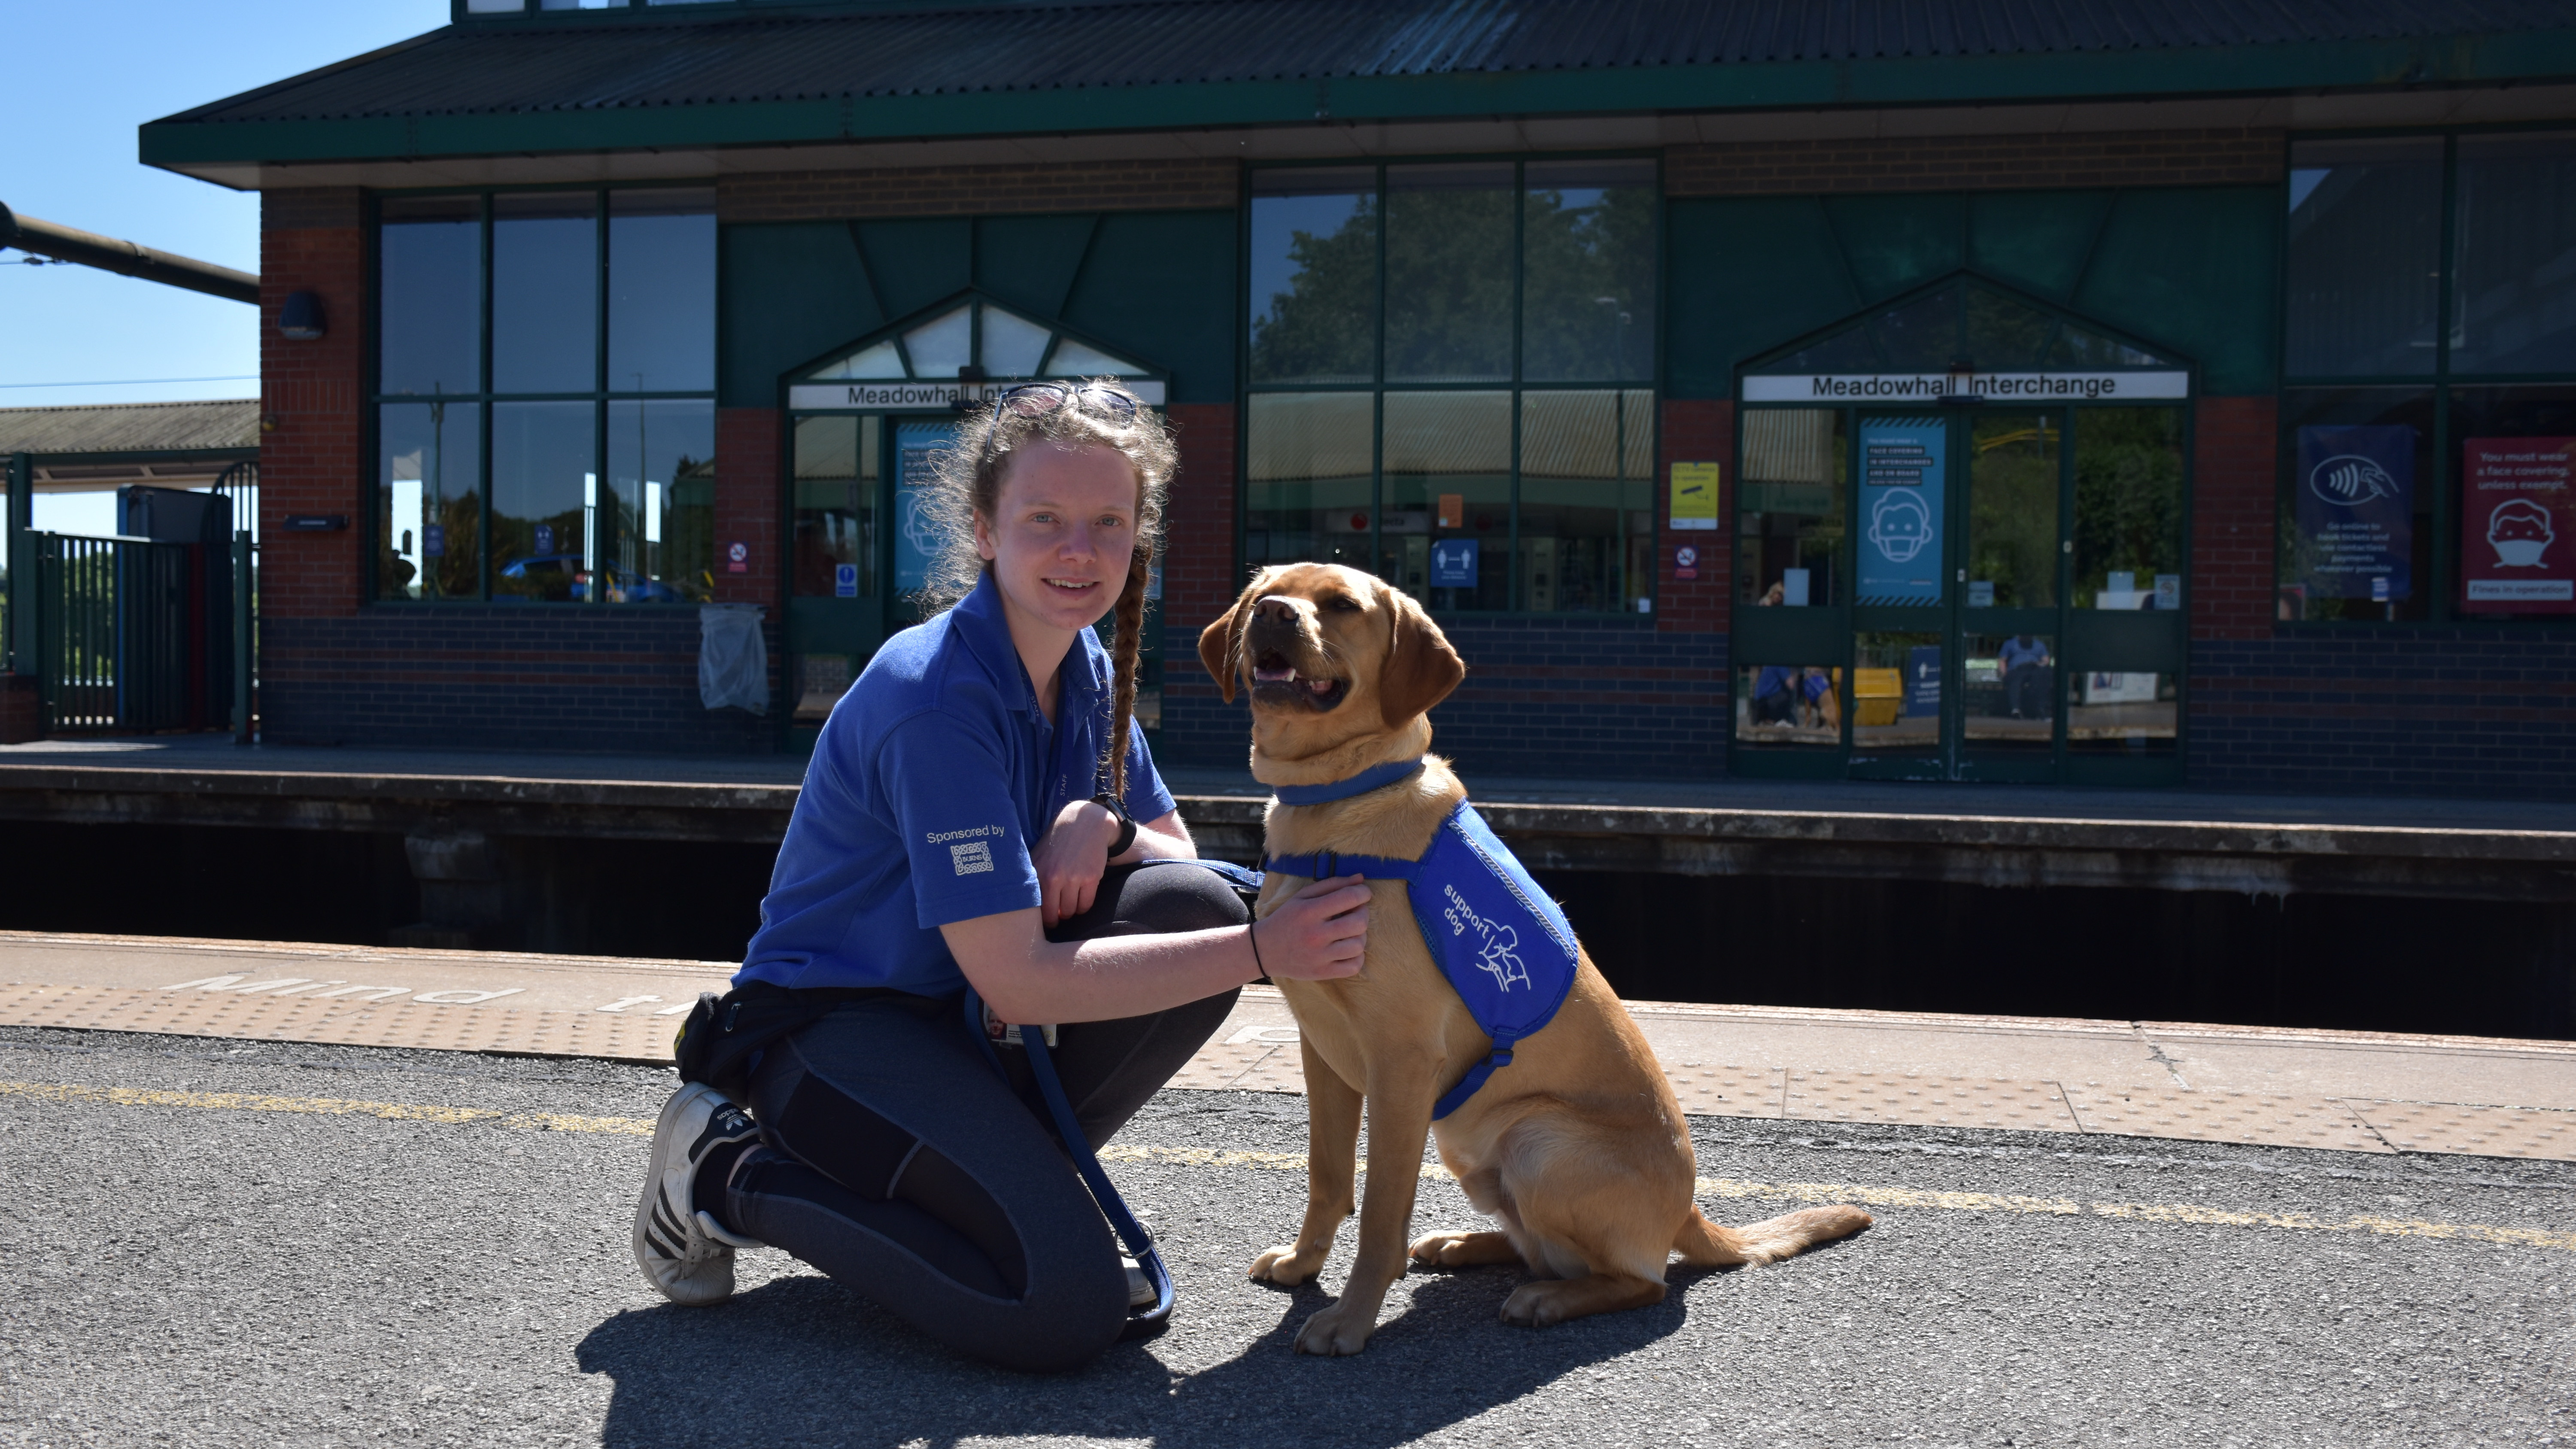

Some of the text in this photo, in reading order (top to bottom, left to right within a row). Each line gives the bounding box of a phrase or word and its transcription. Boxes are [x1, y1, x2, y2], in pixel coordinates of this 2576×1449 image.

[848, 386, 969, 404] Meadowhall
[1813, 376, 2115, 398] Meadowhall Interchange
[2480, 452, 2568, 462] You must wear
[2476, 468, 2485, 476] a
[2487, 465, 2512, 476] face
[2478, 480, 2516, 490] unless
[927, 824, 1004, 844] Sponsored by
[962, 854, 982, 862] BURNS
[1444, 884, 1489, 939] support
[1444, 907, 1465, 936] dog
[160, 975, 526, 1005] Mind
[717, 1108, 738, 1120] adidas
